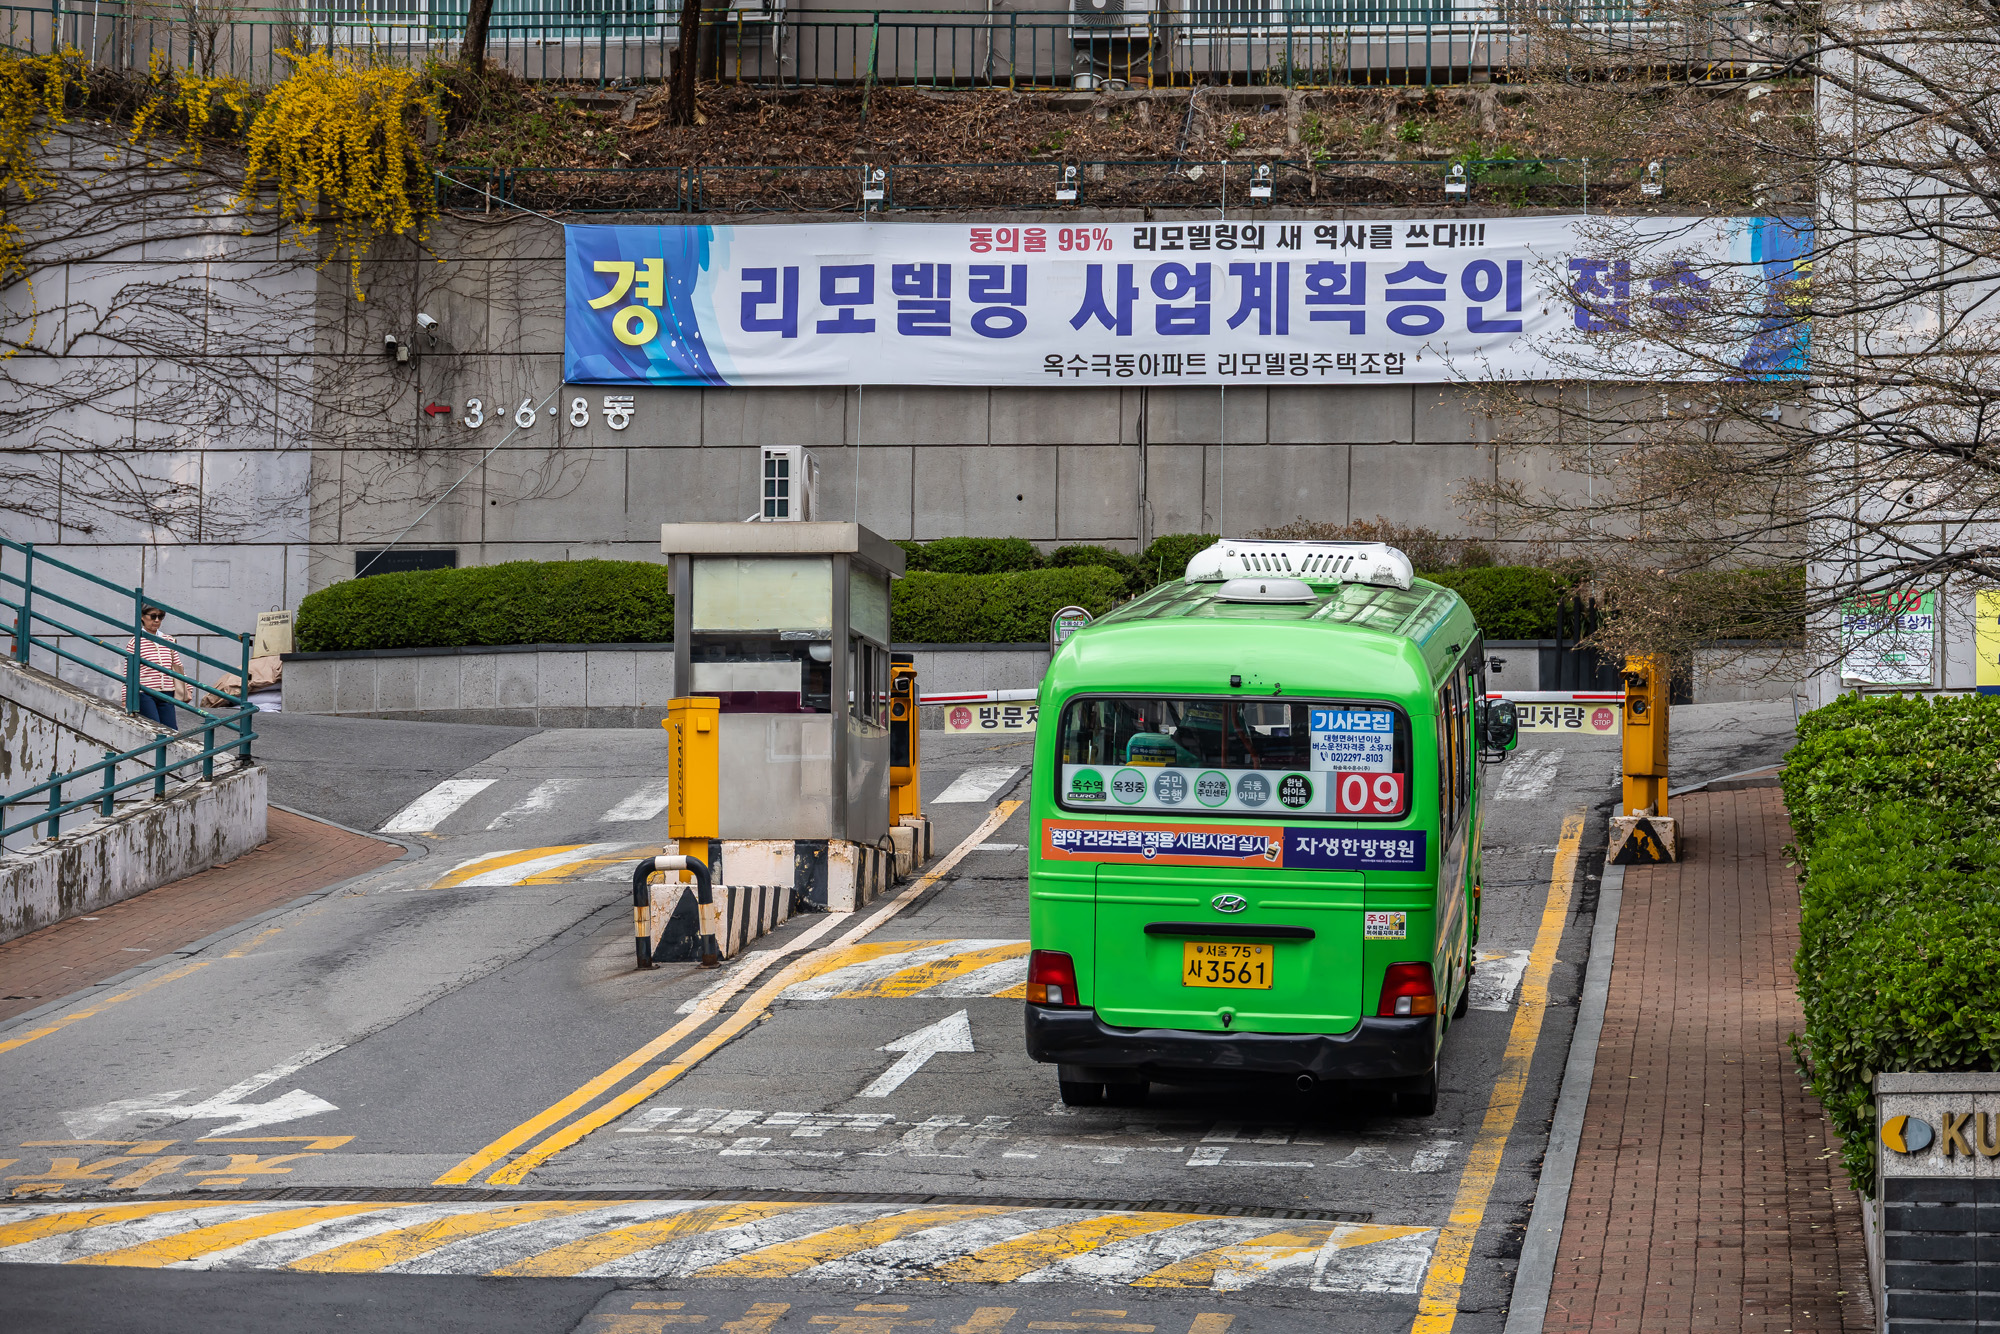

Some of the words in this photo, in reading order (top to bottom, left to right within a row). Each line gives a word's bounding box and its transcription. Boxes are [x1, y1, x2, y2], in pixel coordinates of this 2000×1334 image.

[969, 227, 1047, 253] 동의율
[1058, 227, 1113, 251] 95%
[1133, 225, 1265, 251] 리모델링의
[1276, 224, 1302, 250] 새
[1314, 224, 1393, 251] 역사를
[1405, 223, 1486, 249] 쓰다!!!
[587, 256, 665, 346] 경
[739, 262, 1028, 339] 리모델링
[1069, 257, 1523, 337] 사업계획승인
[1043, 353, 1207, 379] 옥수극동아파트
[1218, 352, 1406, 378] 리모델링주택조합
[1315, 712, 1391, 731] 기사모집
[1312, 743, 1365, 751] 버스운전자격증
[1369, 744, 1392, 752] 소유자
[1331, 752, 1383, 763] 02)2297-8103
[1072, 780, 1104, 792] 옥수역
[1113, 781, 1146, 793] 옥정중
[1159, 775, 1183, 788] 국민
[1198, 781, 1227, 789] 옥수2동
[1243, 780, 1262, 790] 극동
[1159, 789, 1183, 802] 은행
[1197, 788, 1228, 798] 주민센터
[1238, 791, 1267, 801] 아파트
[1282, 787, 1307, 796] 하이츠
[1341, 774, 1399, 813] 09
[1282, 796, 1307, 805] 아파트
[1052, 830, 1082, 846] 첩약
[1083, 831, 1142, 847] 건강보험
[1144, 832, 1175, 849] 적용
[1176, 833, 1236, 850] 시범사업
[1238, 835, 1269, 852] 실시
[1296, 837, 1415, 858] 자생한방병원
[1367, 914, 1388, 925] 주의
[1206, 945, 1228, 958] 서울
[1231, 946, 1252, 958] 75
[1188, 960, 1203, 978] 사
[1206, 961, 1266, 985] 3561
